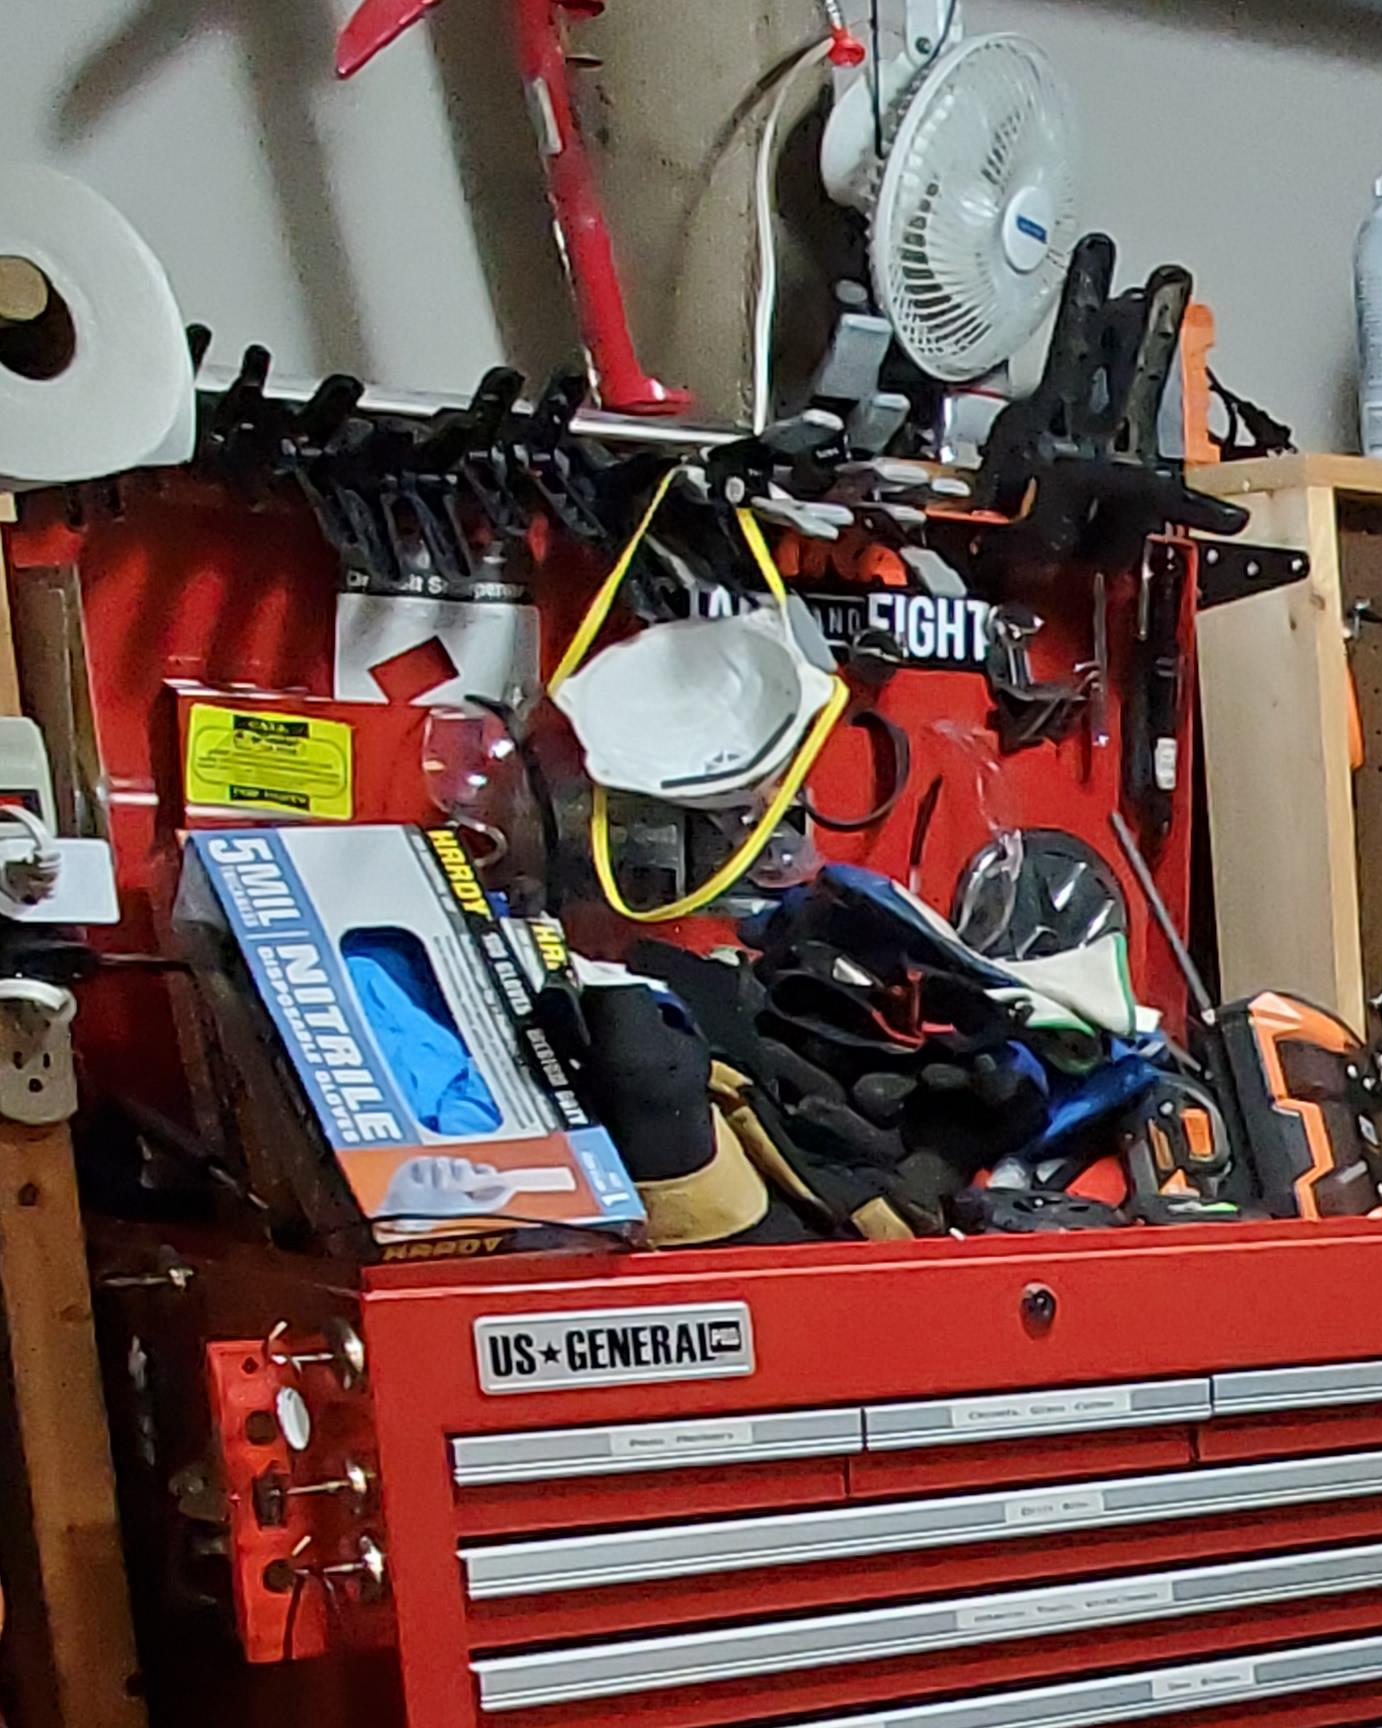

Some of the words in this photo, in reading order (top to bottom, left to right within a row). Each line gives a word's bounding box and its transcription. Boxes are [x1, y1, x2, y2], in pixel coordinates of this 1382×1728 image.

[868, 593, 989, 662] FIGHT
[426, 829, 492, 921] HARDY
[257, 946, 323, 1064] DISPOSABLE
[314, 1070, 361, 1144] GLOVES
[276, 943, 406, 1142] NITRILE
[489, 1333, 536, 1377] US
[565, 1321, 717, 1372] GENERAL
